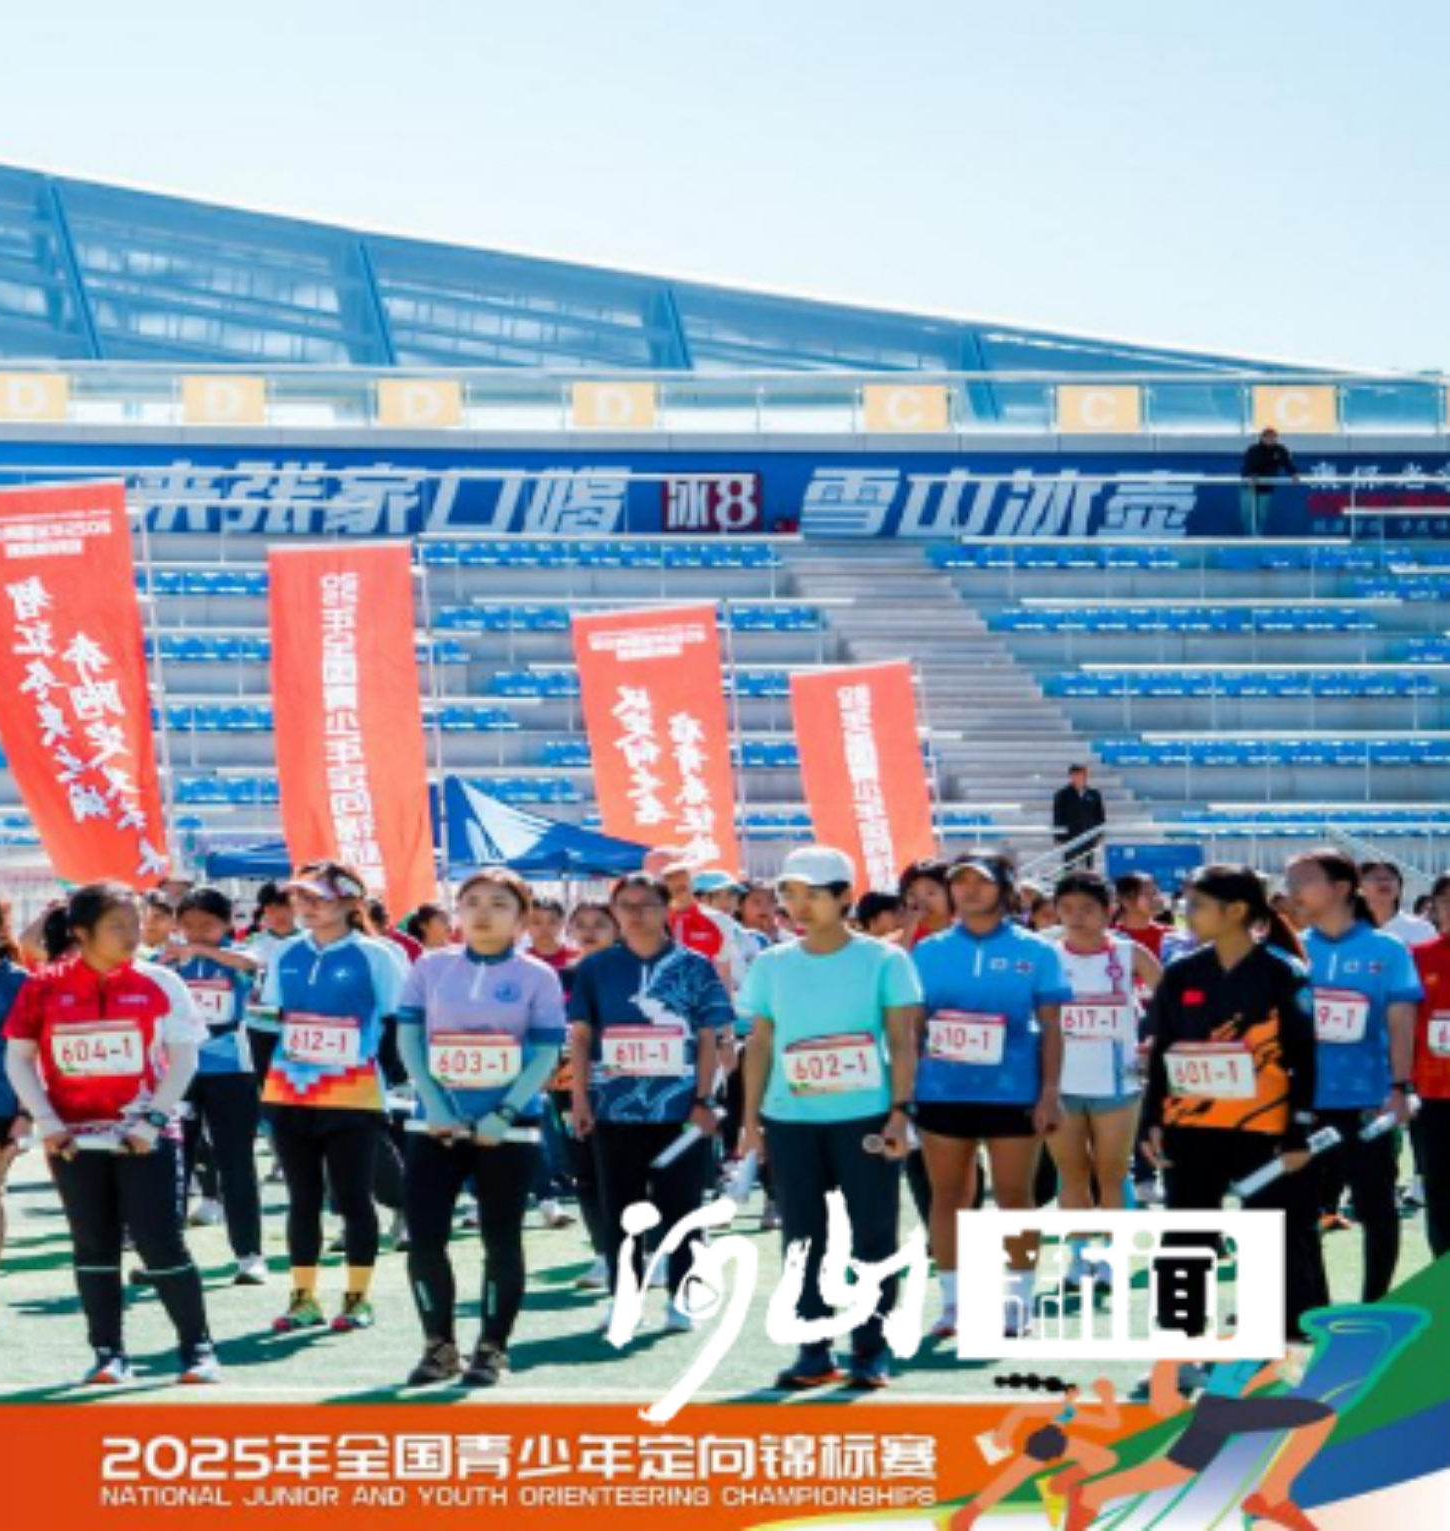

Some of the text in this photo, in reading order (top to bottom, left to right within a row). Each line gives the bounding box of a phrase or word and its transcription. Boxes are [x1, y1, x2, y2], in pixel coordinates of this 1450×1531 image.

[7, 380, 44, 416] D
[203, 383, 242, 418] D
[402, 384, 442, 420] D
[595, 387, 634, 424] D
[886, 391, 923, 427] C
[1079, 391, 1117, 427] C
[1274, 391, 1312, 427] C
[1063, 1009, 1119, 1031] 617-1
[1318, 1005, 1356, 1030] 9-1
[61, 1036, 133, 1064] 604-1
[289, 1028, 348, 1053] 612-1
[932, 1023, 992, 1050] 610-1
[437, 1044, 511, 1074] 603-1
[615, 1041, 670, 1063] 611-1
[793, 1050, 869, 1080] 602-1
[1174, 1057, 1240, 1085] 601-1
